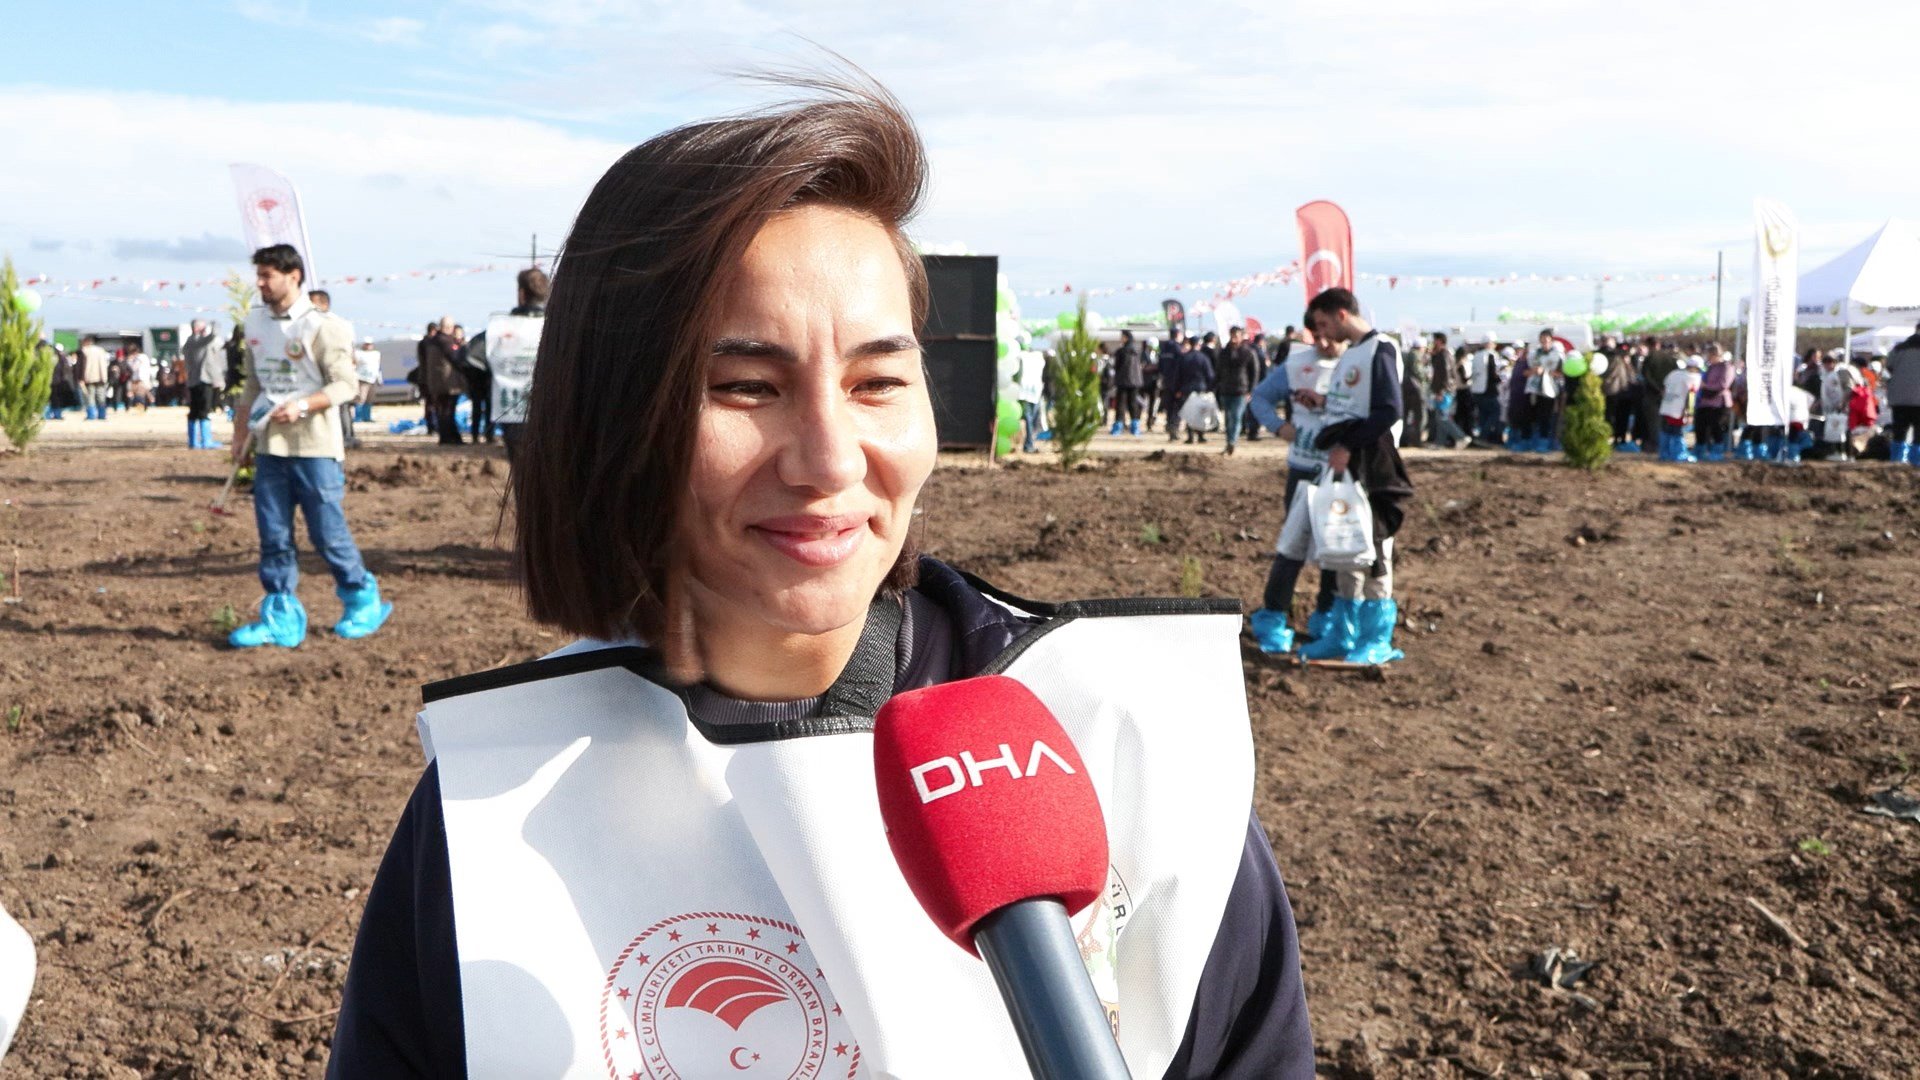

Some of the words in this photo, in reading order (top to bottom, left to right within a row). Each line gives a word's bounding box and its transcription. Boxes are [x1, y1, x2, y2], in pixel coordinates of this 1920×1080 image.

[909, 739, 1077, 804] DHA
[696, 944, 745, 956] TARIM
[754, 951, 773, 966] VE
[778, 964, 819, 1010] ORMAN
[796, 1018, 823, 1080] BAKANL
